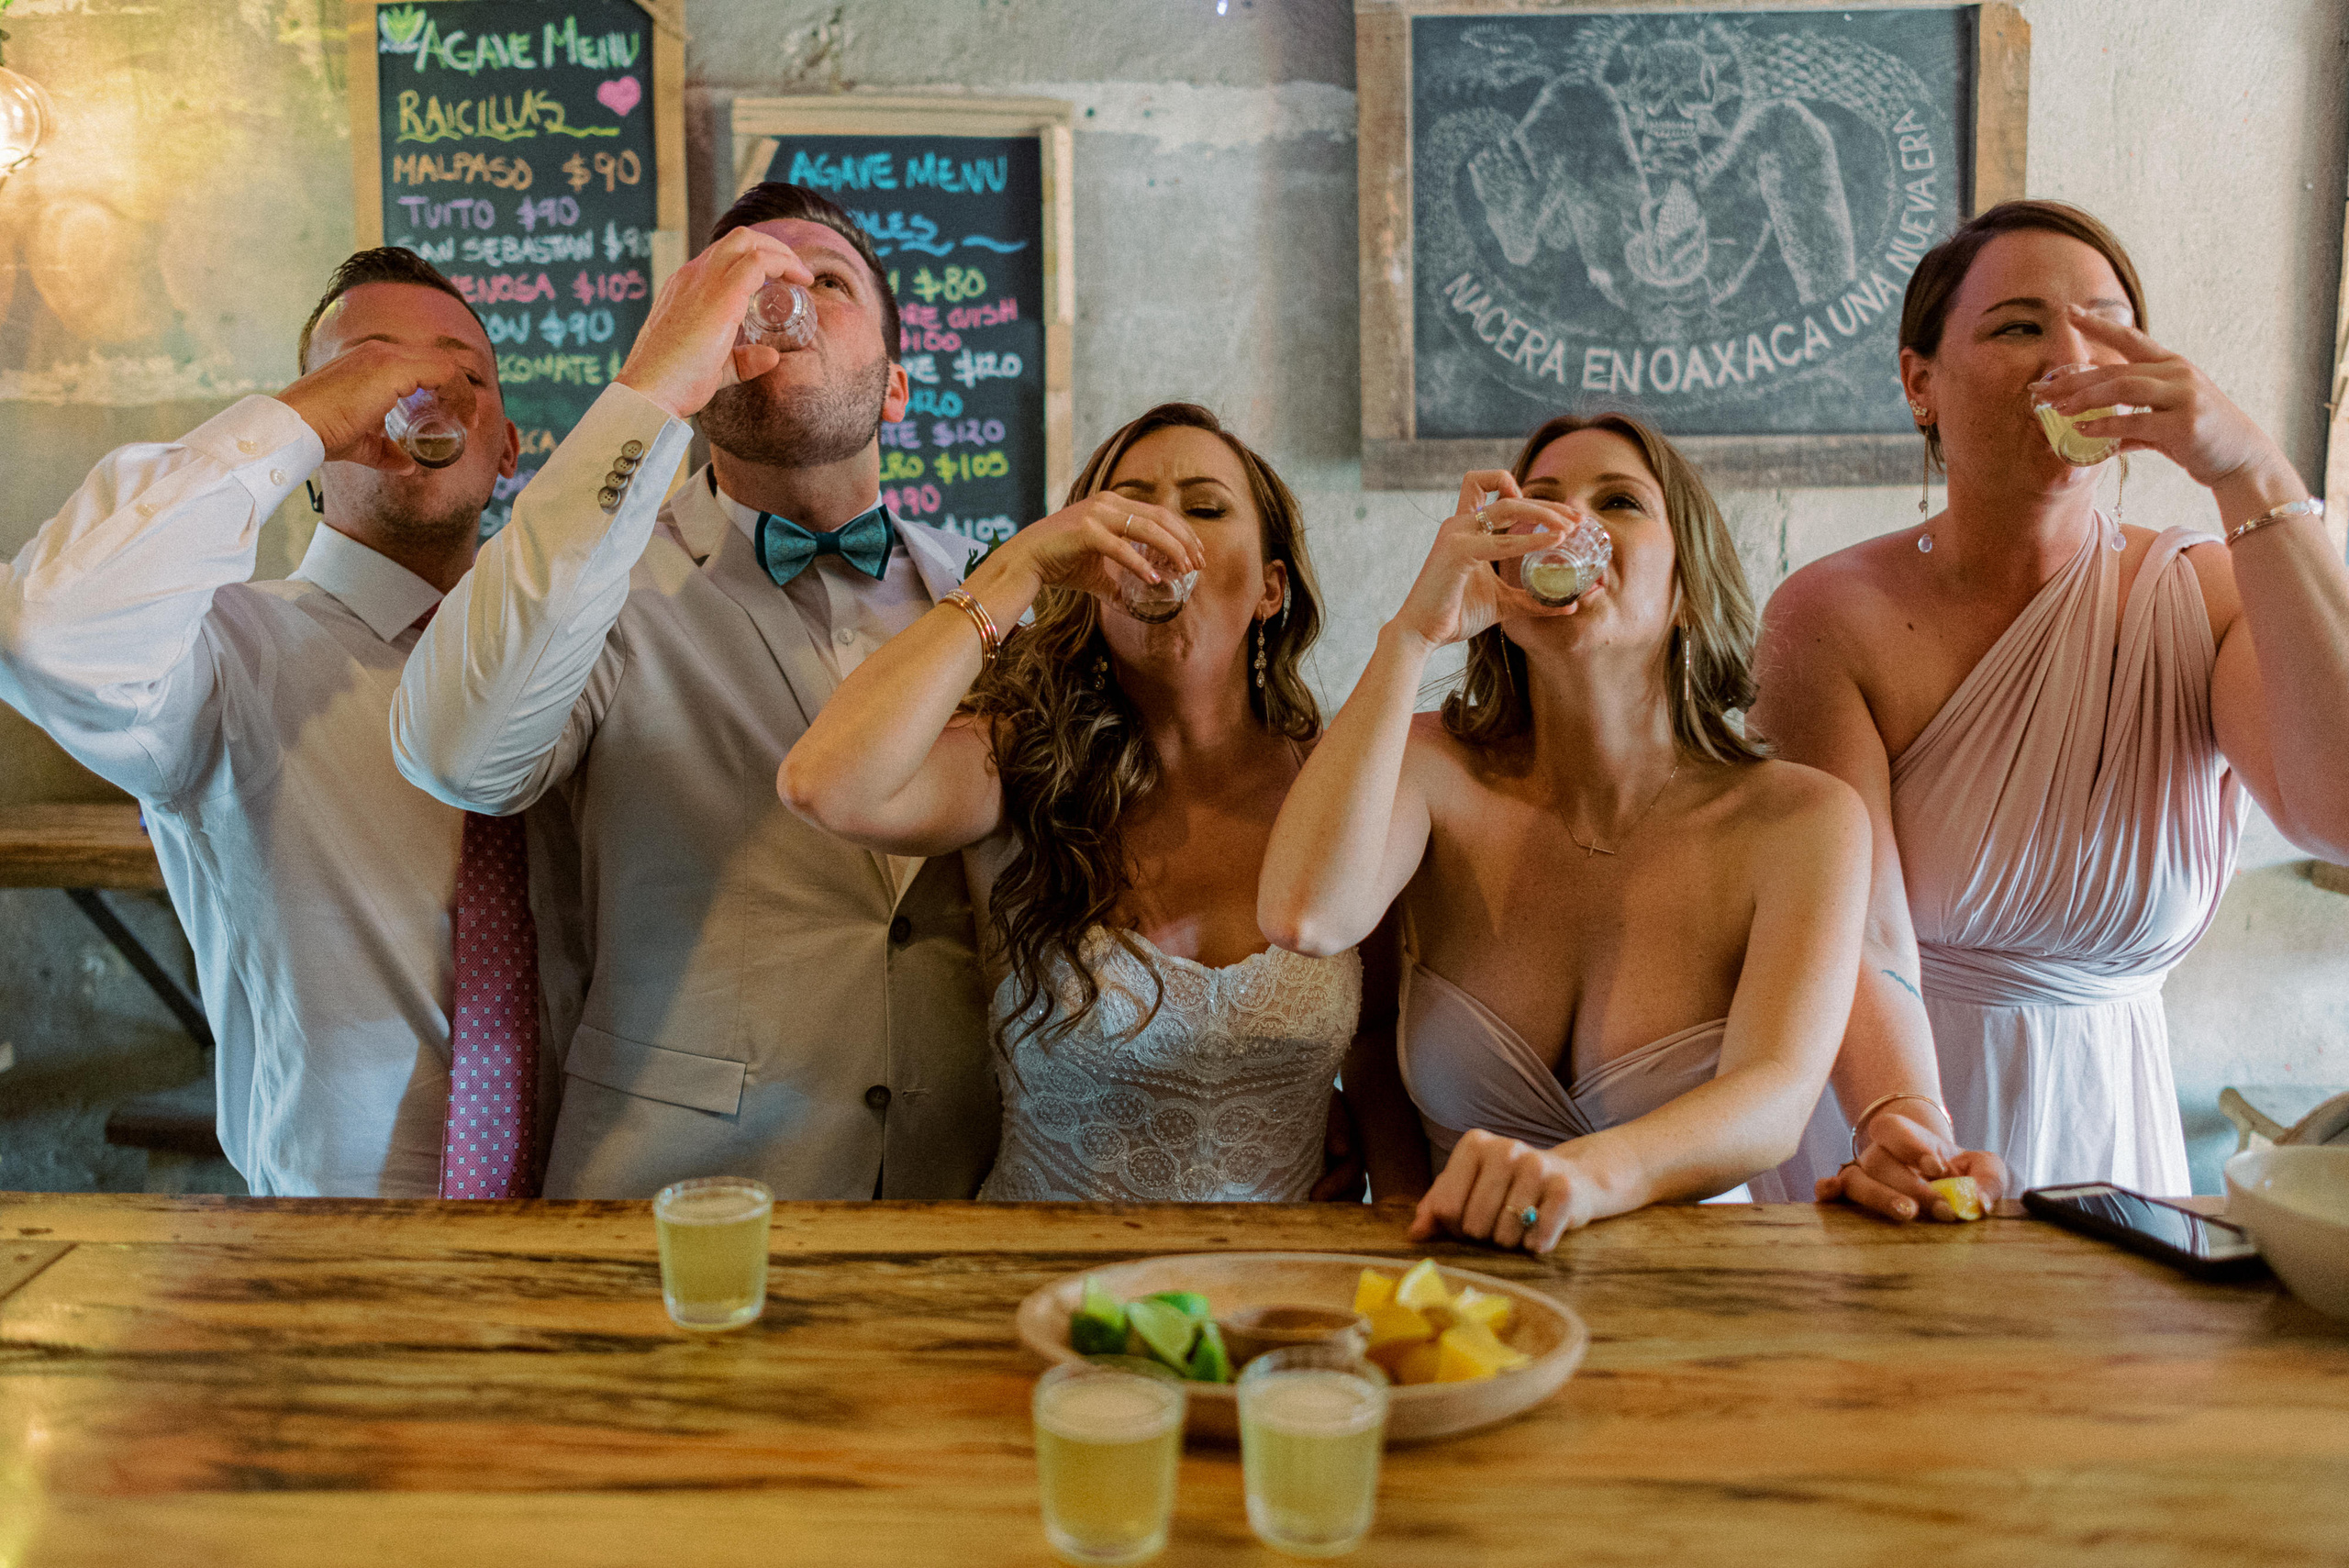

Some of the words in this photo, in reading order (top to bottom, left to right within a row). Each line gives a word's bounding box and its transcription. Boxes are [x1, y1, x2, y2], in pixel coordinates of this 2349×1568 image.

[414, 18, 537, 75] AGAVE
[1892, 107, 1934, 172] ERA
[562, 150, 641, 193] $90
[788, 150, 899, 192] AGAVE
[905, 151, 1008, 194] MENU
[516, 195, 581, 232] $90
[1885, 172, 1938, 276] NUEVA
[573, 270, 647, 306] $105
[912, 263, 987, 303] $80
[1826, 271, 1903, 337] UNA
[539, 306, 616, 348] $90
[1443, 272, 1565, 384] NACERA
[1581, 346, 1644, 395] EN
[1649, 315, 1832, 394] OAXACA
